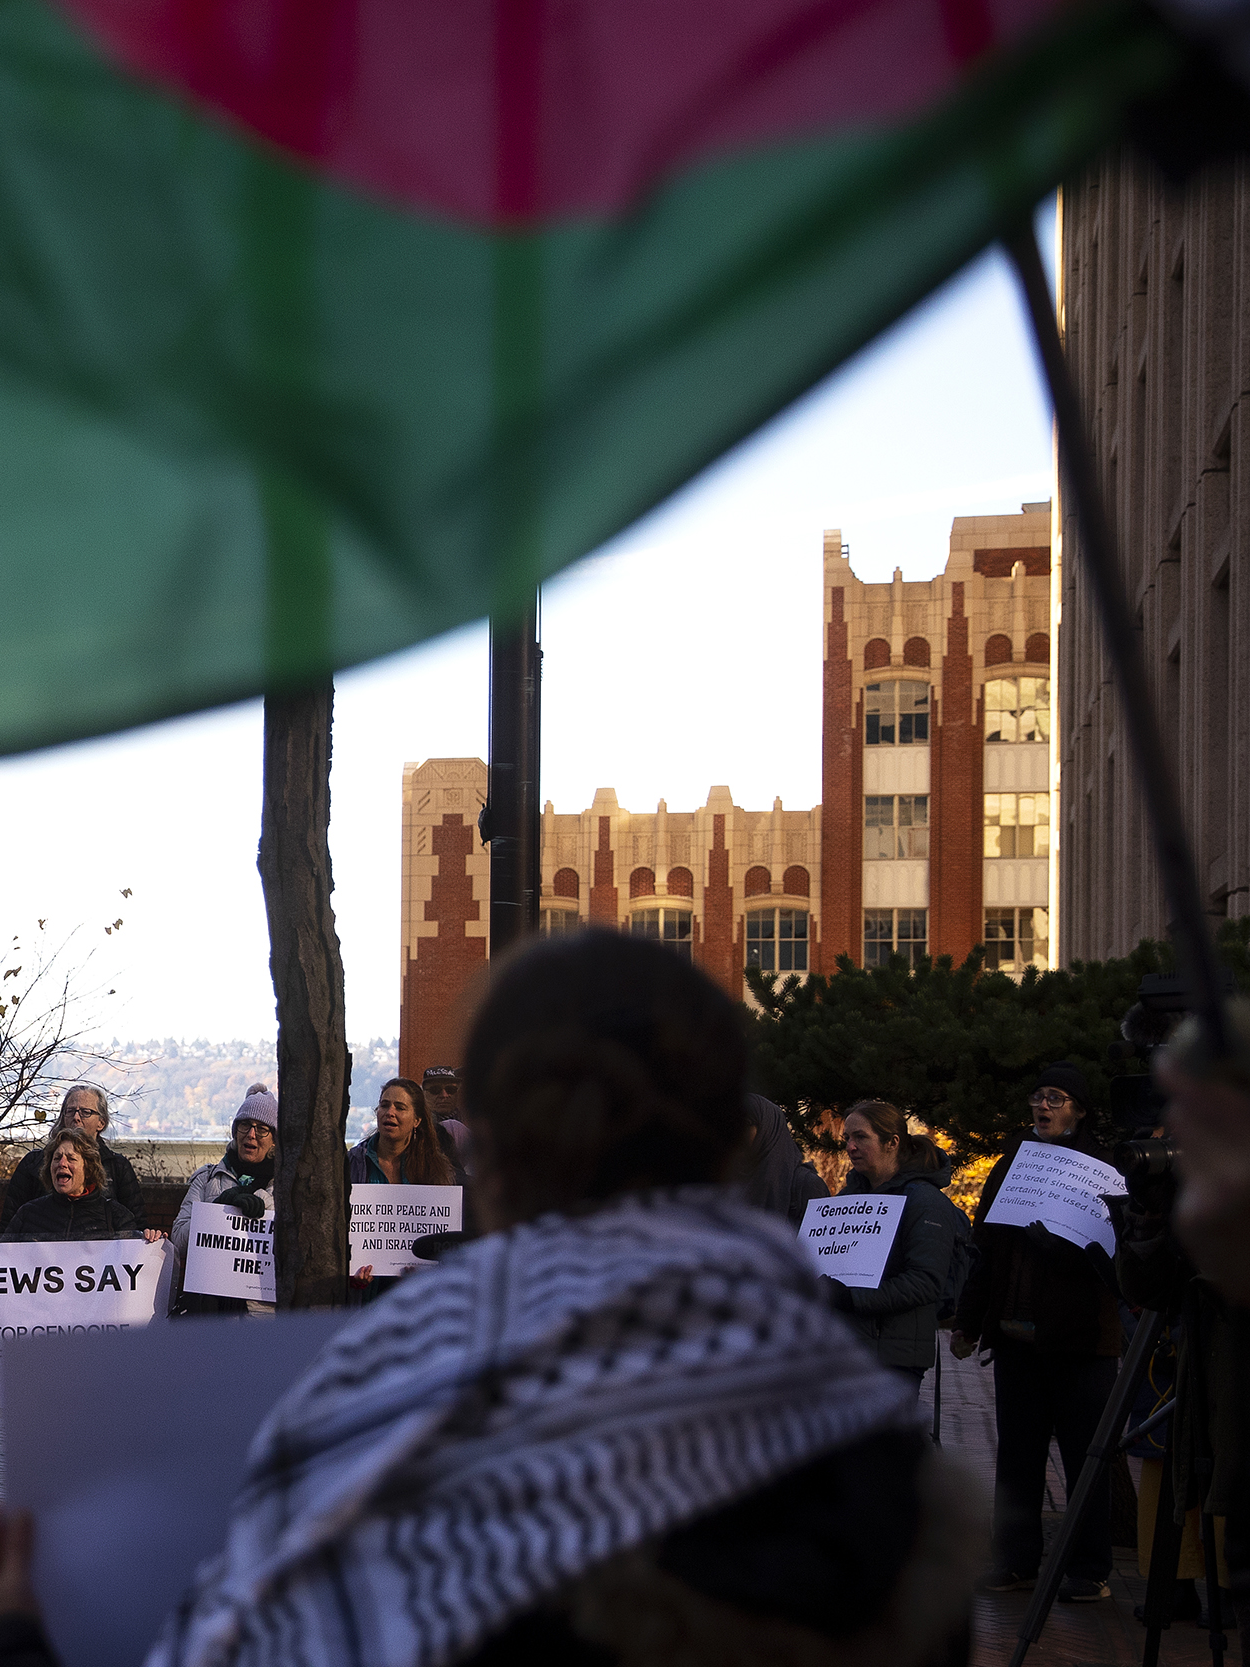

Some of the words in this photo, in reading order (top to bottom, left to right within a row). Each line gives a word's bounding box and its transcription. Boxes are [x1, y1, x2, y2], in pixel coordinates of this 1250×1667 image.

[1032, 1150, 1051, 1160] also
[1053, 1154, 1090, 1171] oppose
[1092, 1168, 1110, 1182] the
[1015, 1161, 1045, 1172] giving
[1046, 1166, 1066, 1177] any
[1068, 1171, 1110, 1195] military
[1023, 1174, 1049, 1184] Israel
[1050, 1179, 1078, 1193] since
[1080, 1188, 1090, 1199] it
[375, 1204, 394, 1216] FOR
[396, 1204, 427, 1217] PEACE
[429, 1205, 451, 1218] AND
[815, 1201, 873, 1217] “Genocide
[876, 1202, 889, 1215] is
[1005, 1184, 1046, 1198] certainly
[1047, 1190, 1061, 1200] be
[1063, 1196, 1089, 1211] used
[1090, 1208, 1102, 1219] to
[226, 1215, 266, 1234] “URGE
[350, 1221, 376, 1233] STICE
[378, 1221, 396, 1233] FOR
[399, 1222, 449, 1234] PALESTINE
[808, 1224, 828, 1237] not
[828, 1226, 837, 1236] a
[838, 1220, 882, 1235] Jewish
[196, 1232, 270, 1255] IMMEDIATE
[361, 1239, 383, 1250] AND
[385, 1239, 414, 1250] ISRAE
[233, 1257, 271, 1275] FIRE.”
[74, 1263, 144, 1293] SAY
